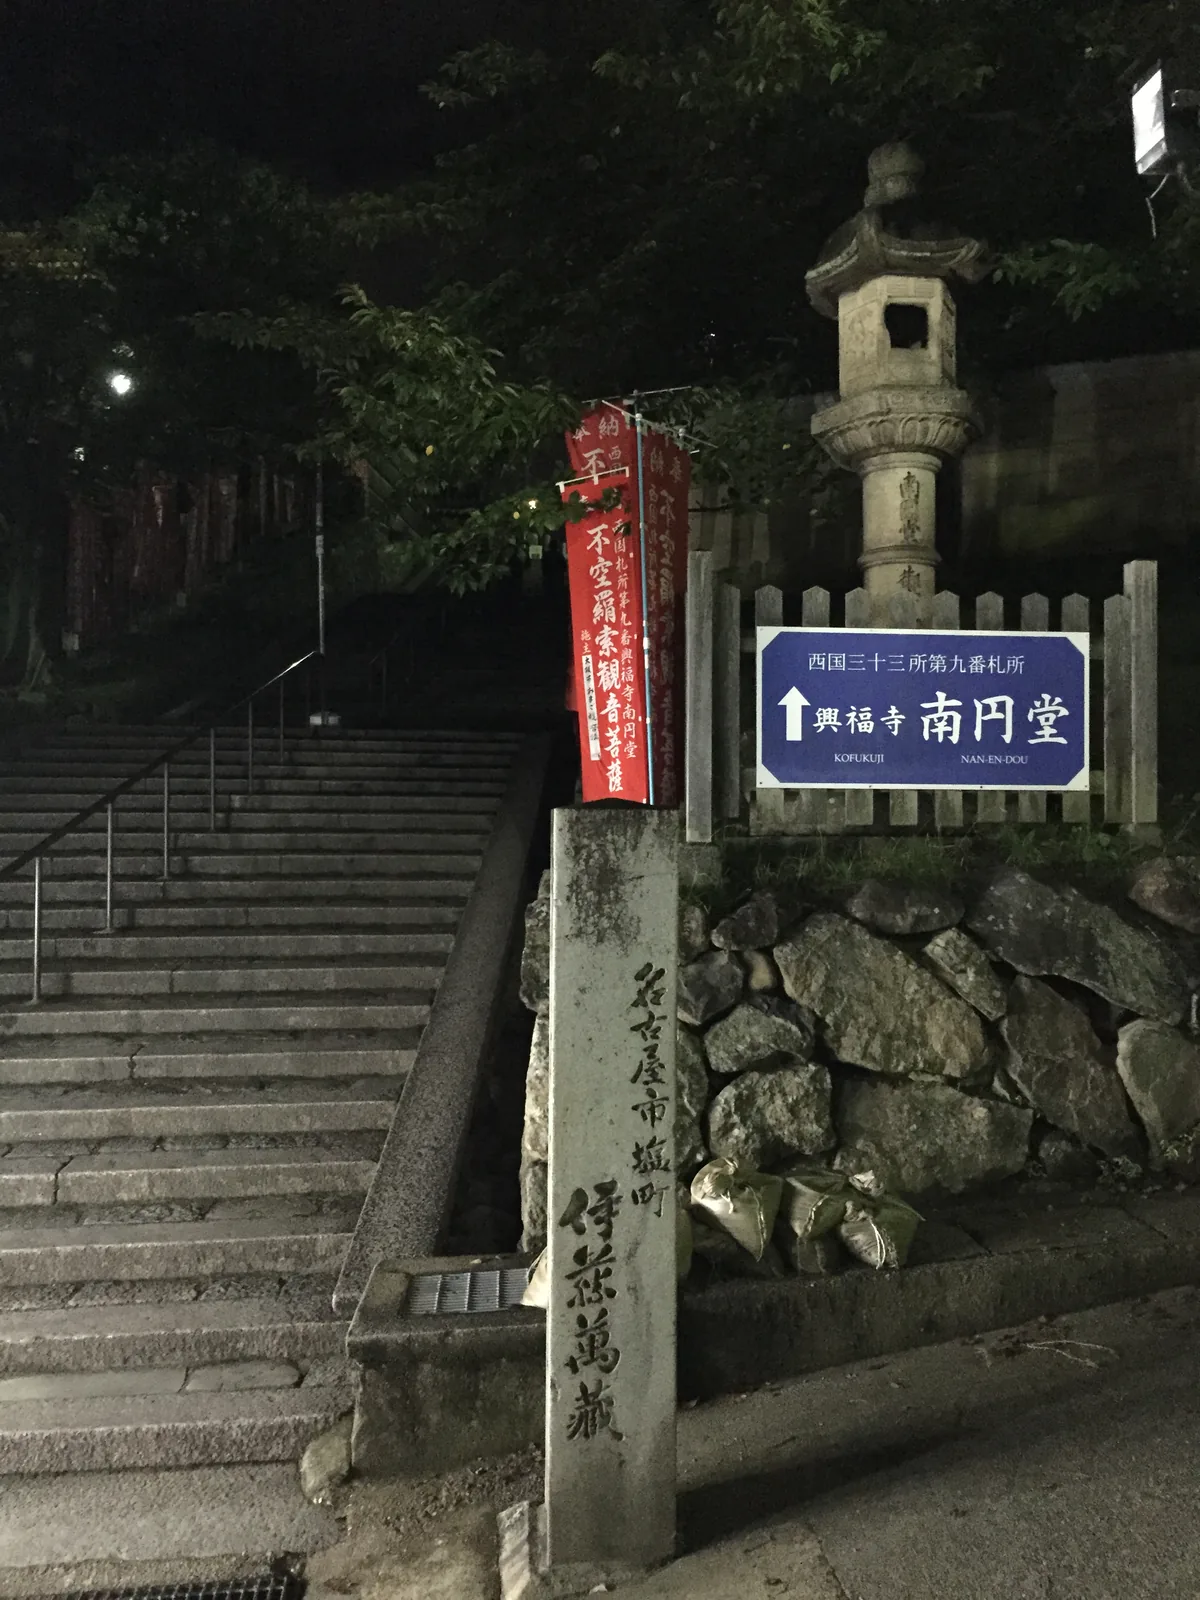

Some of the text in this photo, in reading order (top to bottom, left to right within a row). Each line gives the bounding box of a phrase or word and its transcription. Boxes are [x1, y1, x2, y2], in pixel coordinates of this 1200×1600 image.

[581, 448, 606, 482] 不
[808, 652, 1026, 675] 西国三十三所第九番札所
[812, 690, 1071, 745] 興福寺 南円堂
[834, 753, 885, 764] KOFUKUJI
[960, 754, 1029, 765] NAN-EN-DOU
